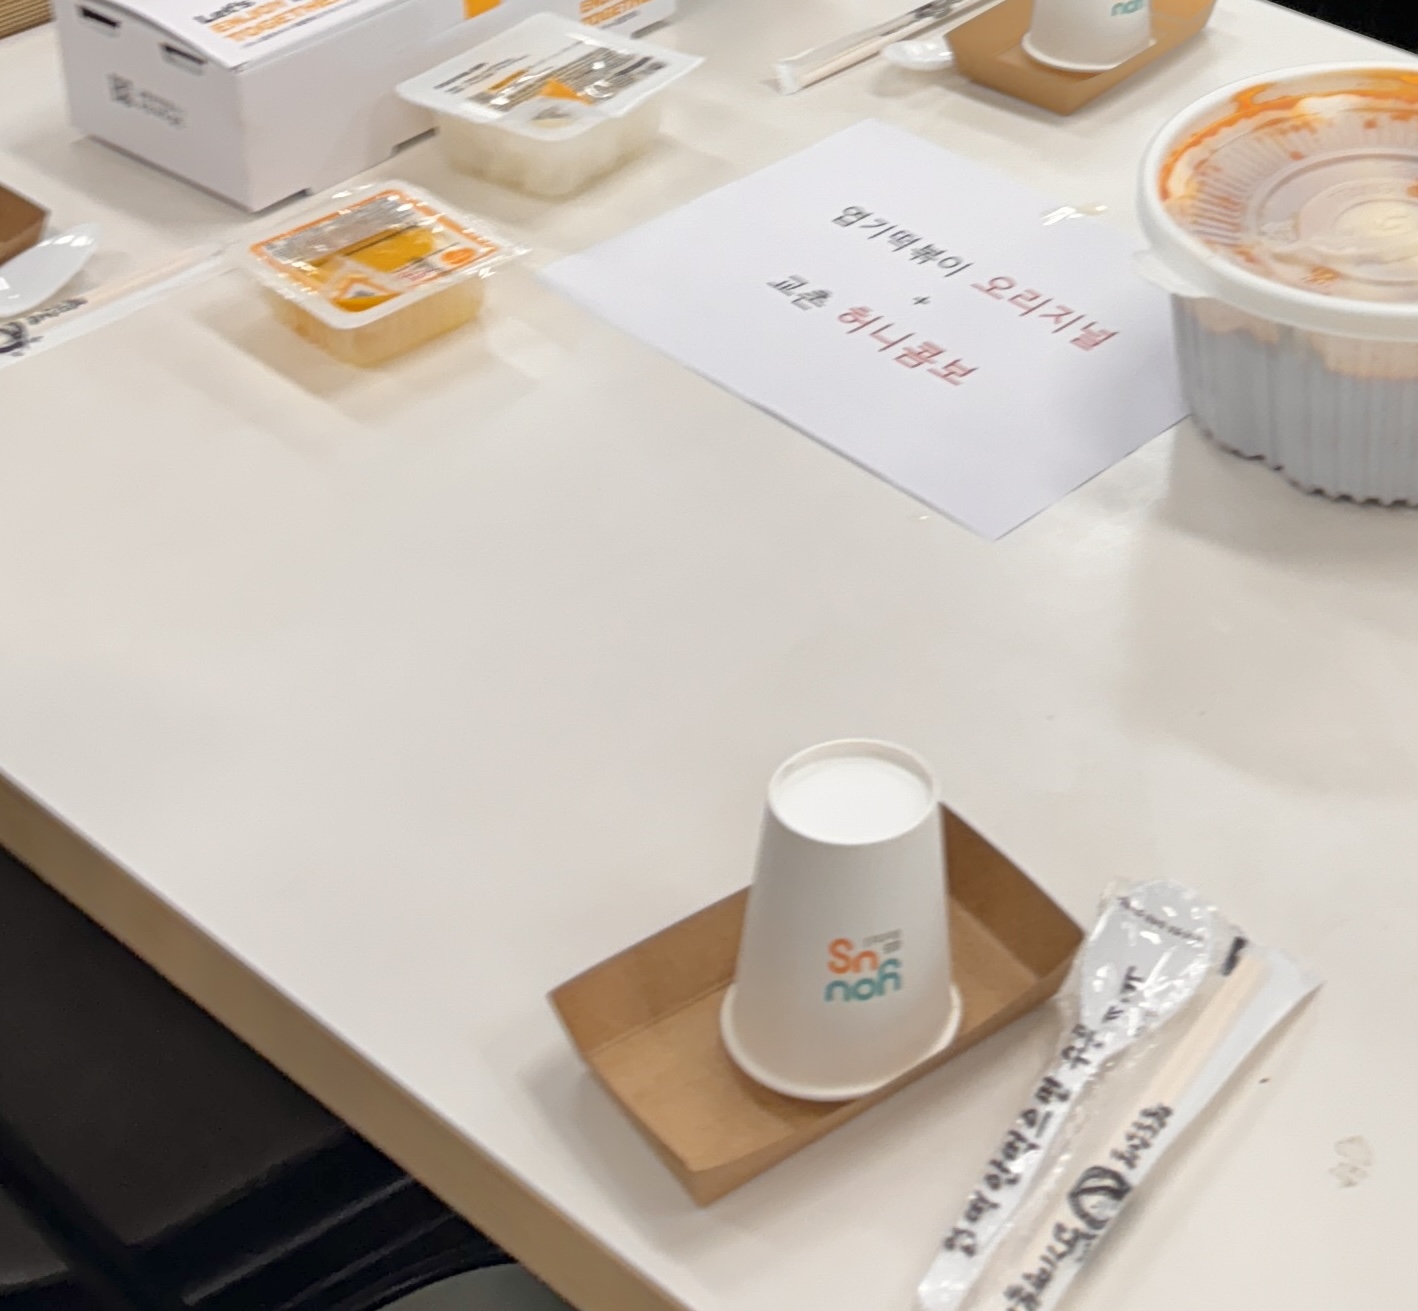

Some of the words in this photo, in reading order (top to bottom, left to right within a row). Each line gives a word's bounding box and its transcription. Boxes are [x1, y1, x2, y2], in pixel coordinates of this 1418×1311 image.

[765, 274, 833, 310] 교촌
[837, 305, 980, 386] 허니콤보
[832, 205, 974, 278] 엽기떡볶이
[970, 276, 1120, 351] 오리지널
